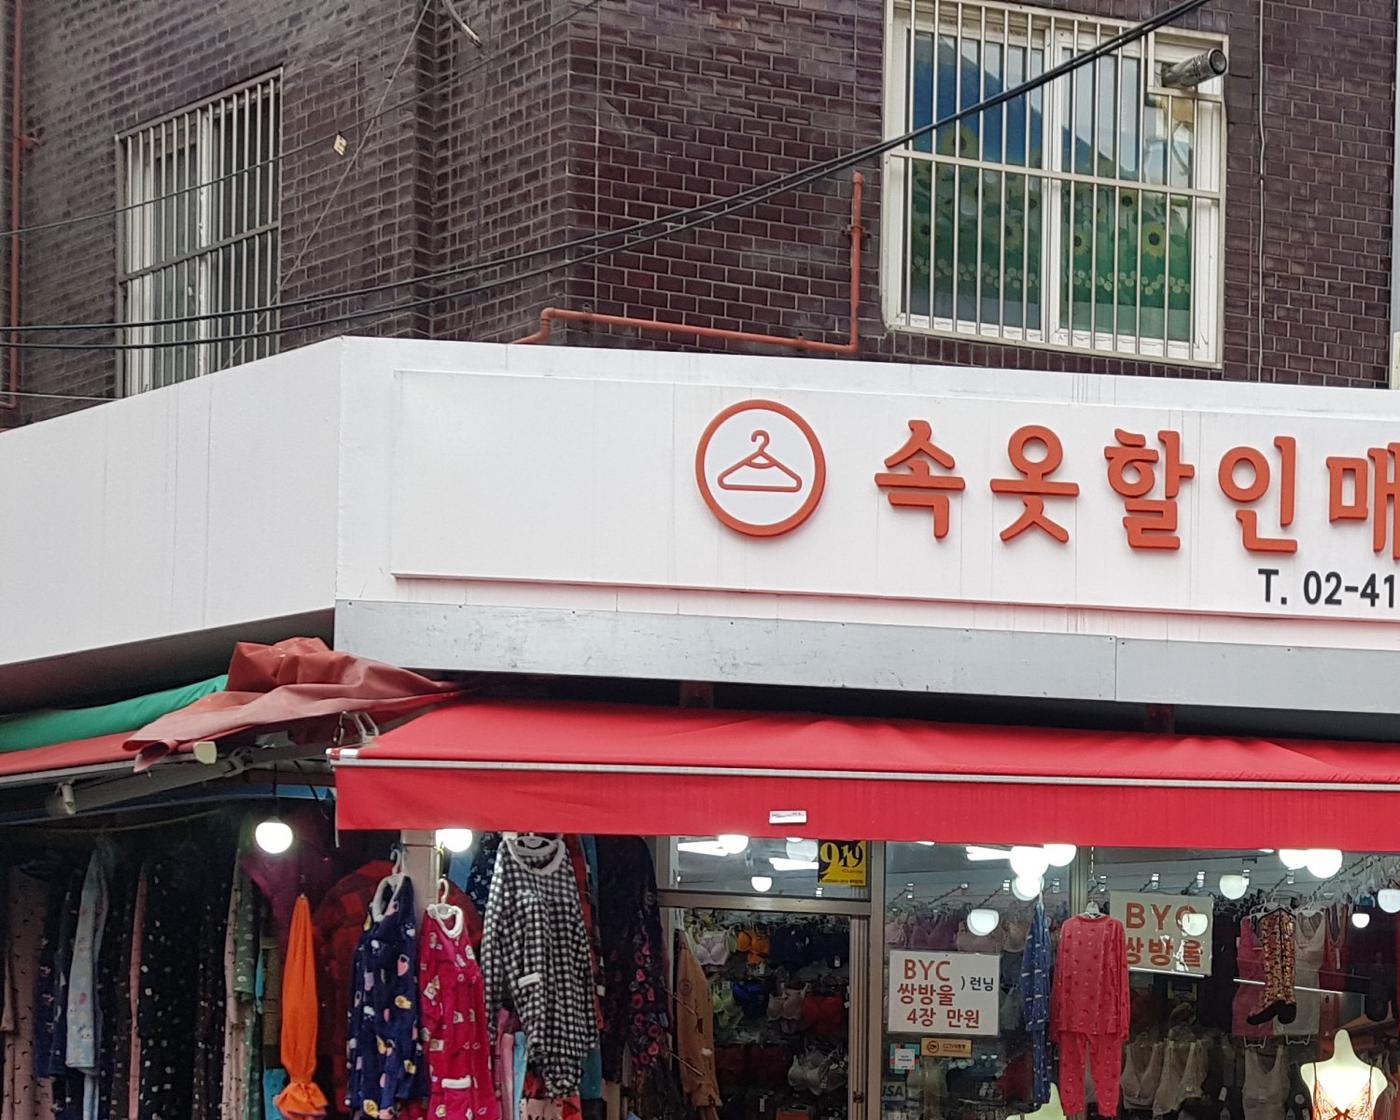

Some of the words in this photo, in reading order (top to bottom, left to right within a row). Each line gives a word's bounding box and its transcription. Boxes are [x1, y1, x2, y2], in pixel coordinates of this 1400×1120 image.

[1257, 568, 1289, 606] T.
[904, 958, 951, 981] BYC
[897, 983, 956, 1007] 쌍방울
[969, 976, 994, 992] 런닝
[906, 1007, 937, 1027] 4장
[946, 1008, 980, 1029] 만원
